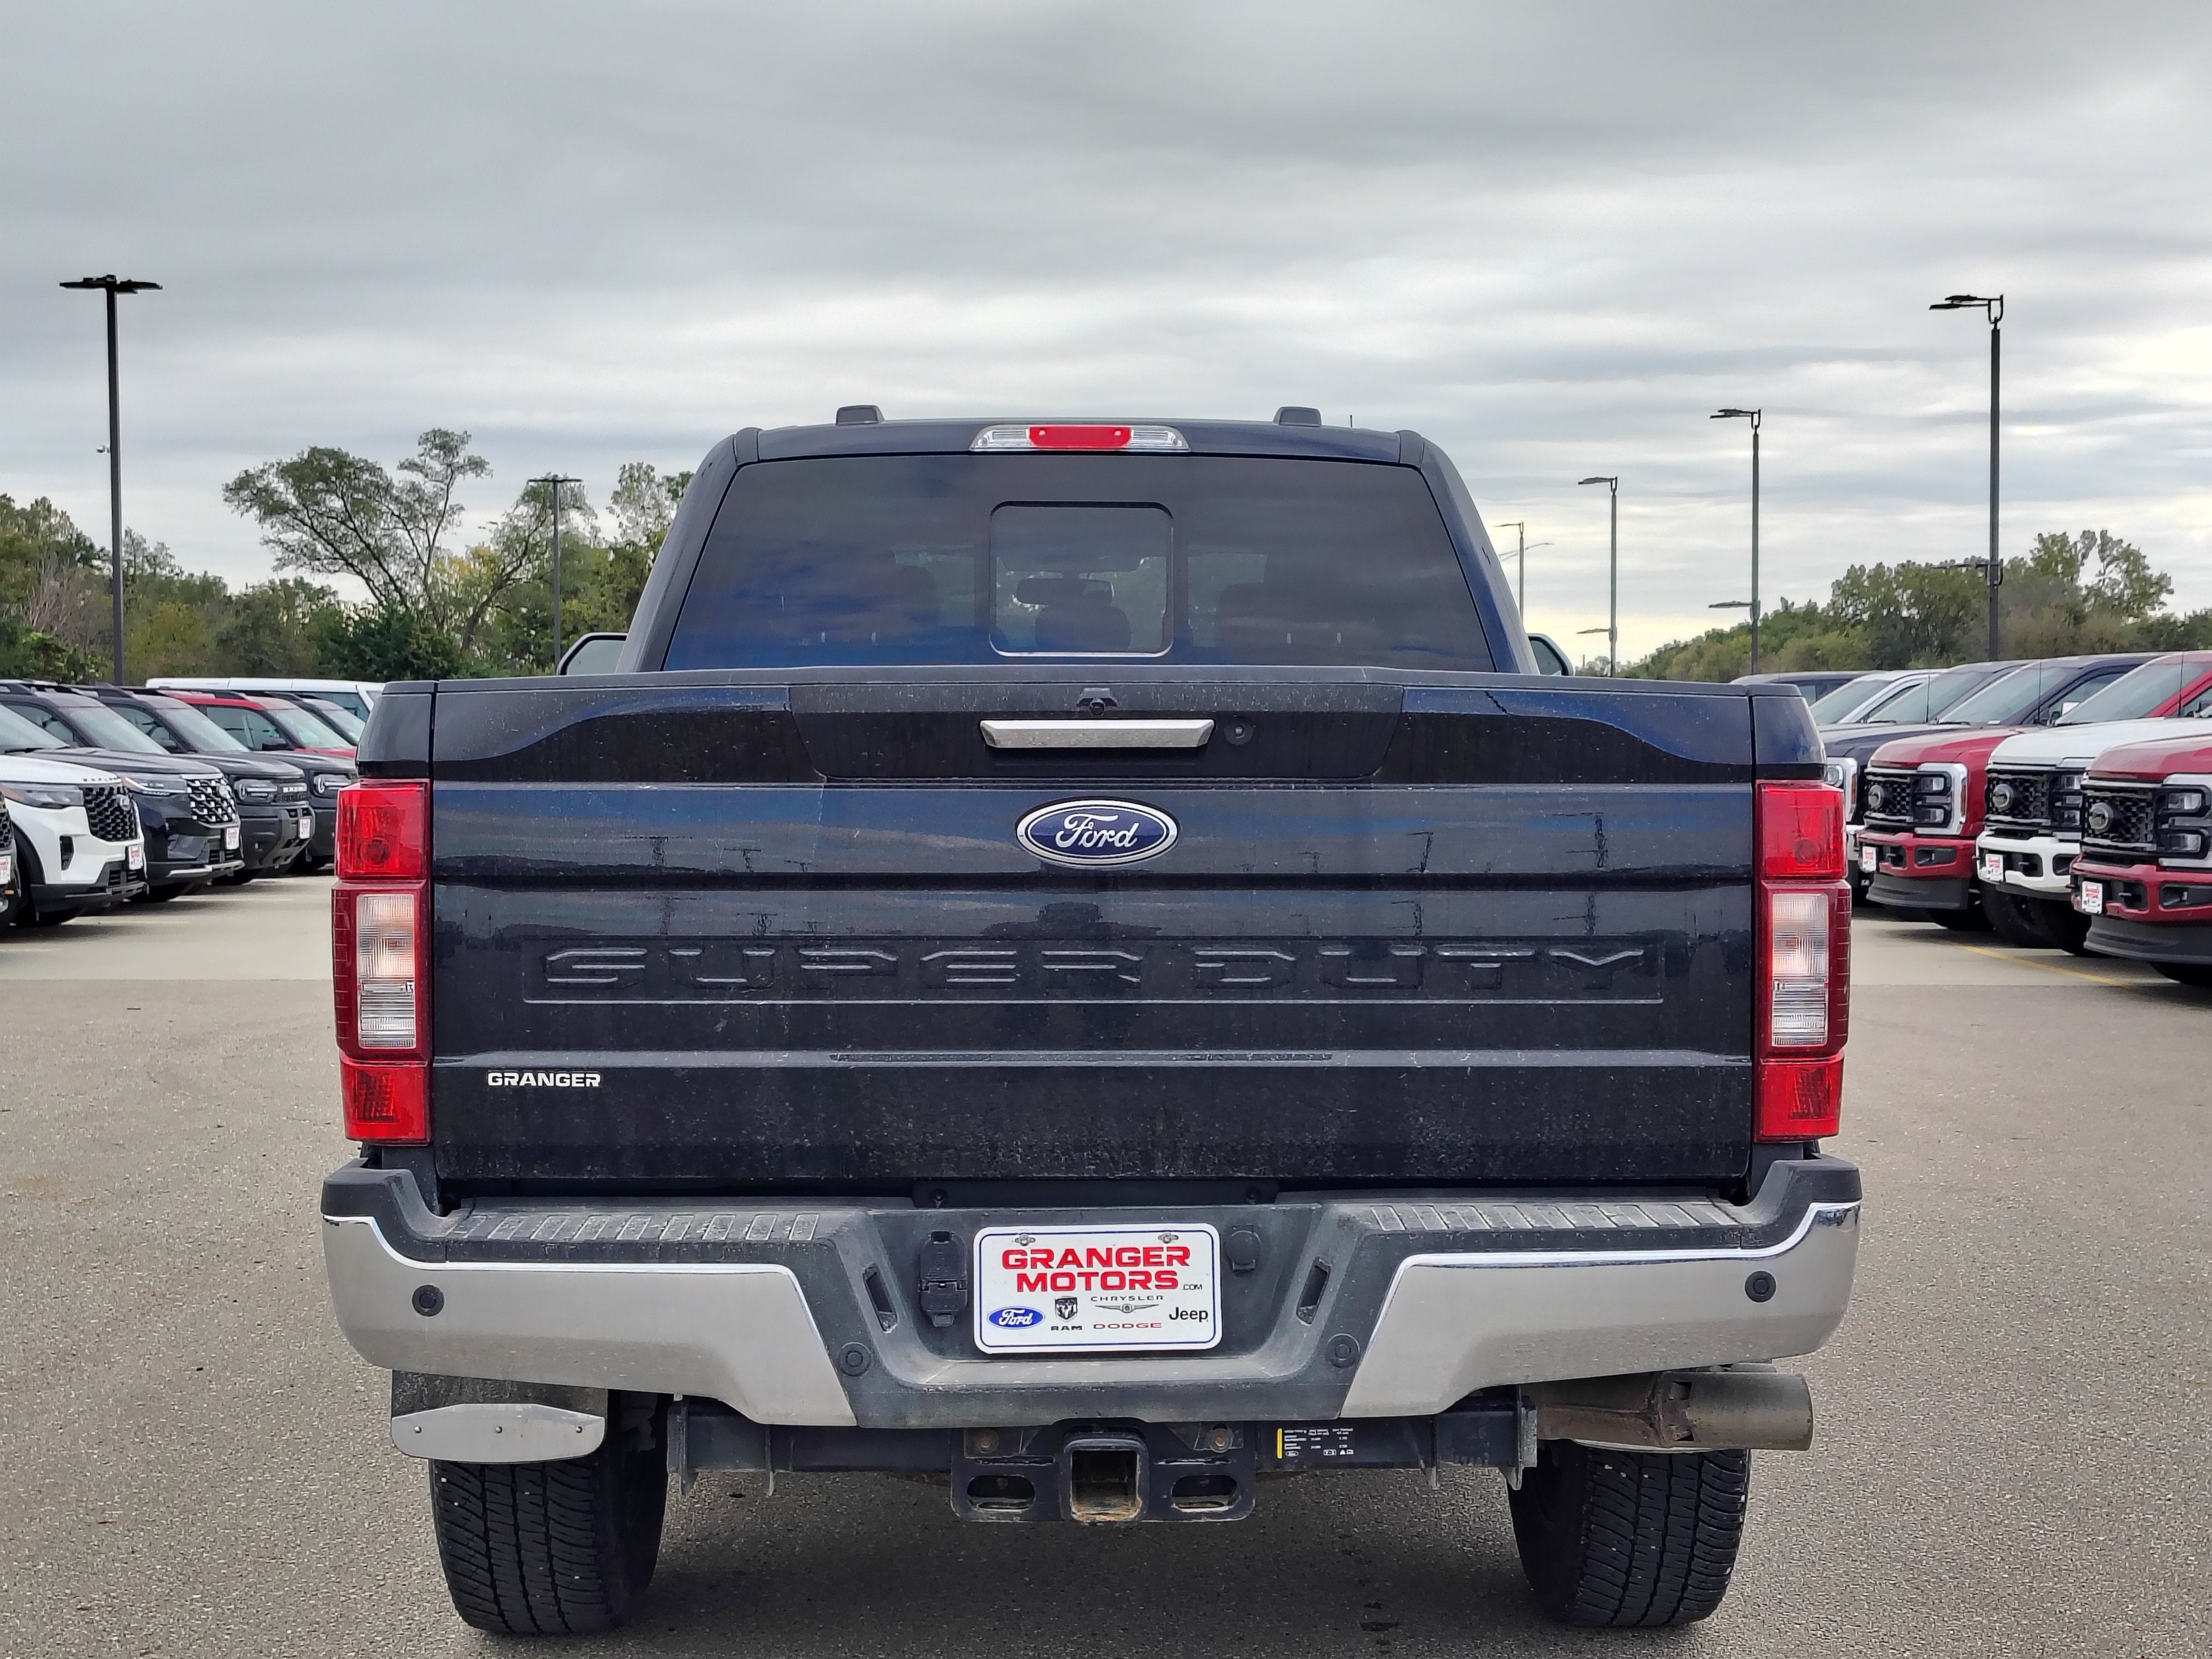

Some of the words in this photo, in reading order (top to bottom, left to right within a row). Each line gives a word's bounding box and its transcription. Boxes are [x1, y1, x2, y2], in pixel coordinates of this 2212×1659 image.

[1055, 813, 1139, 848] Ford
[544, 946, 1141, 990] SUPER
[1192, 945, 1645, 990] DUTY
[488, 1072, 601, 1087] GRANGER
[1002, 1246, 1191, 1270] GRANGER
[1016, 1270, 1179, 1292] MOTORS
[998, 1309, 1033, 1326] Ford
[1169, 1306, 1209, 1323] Jeep
